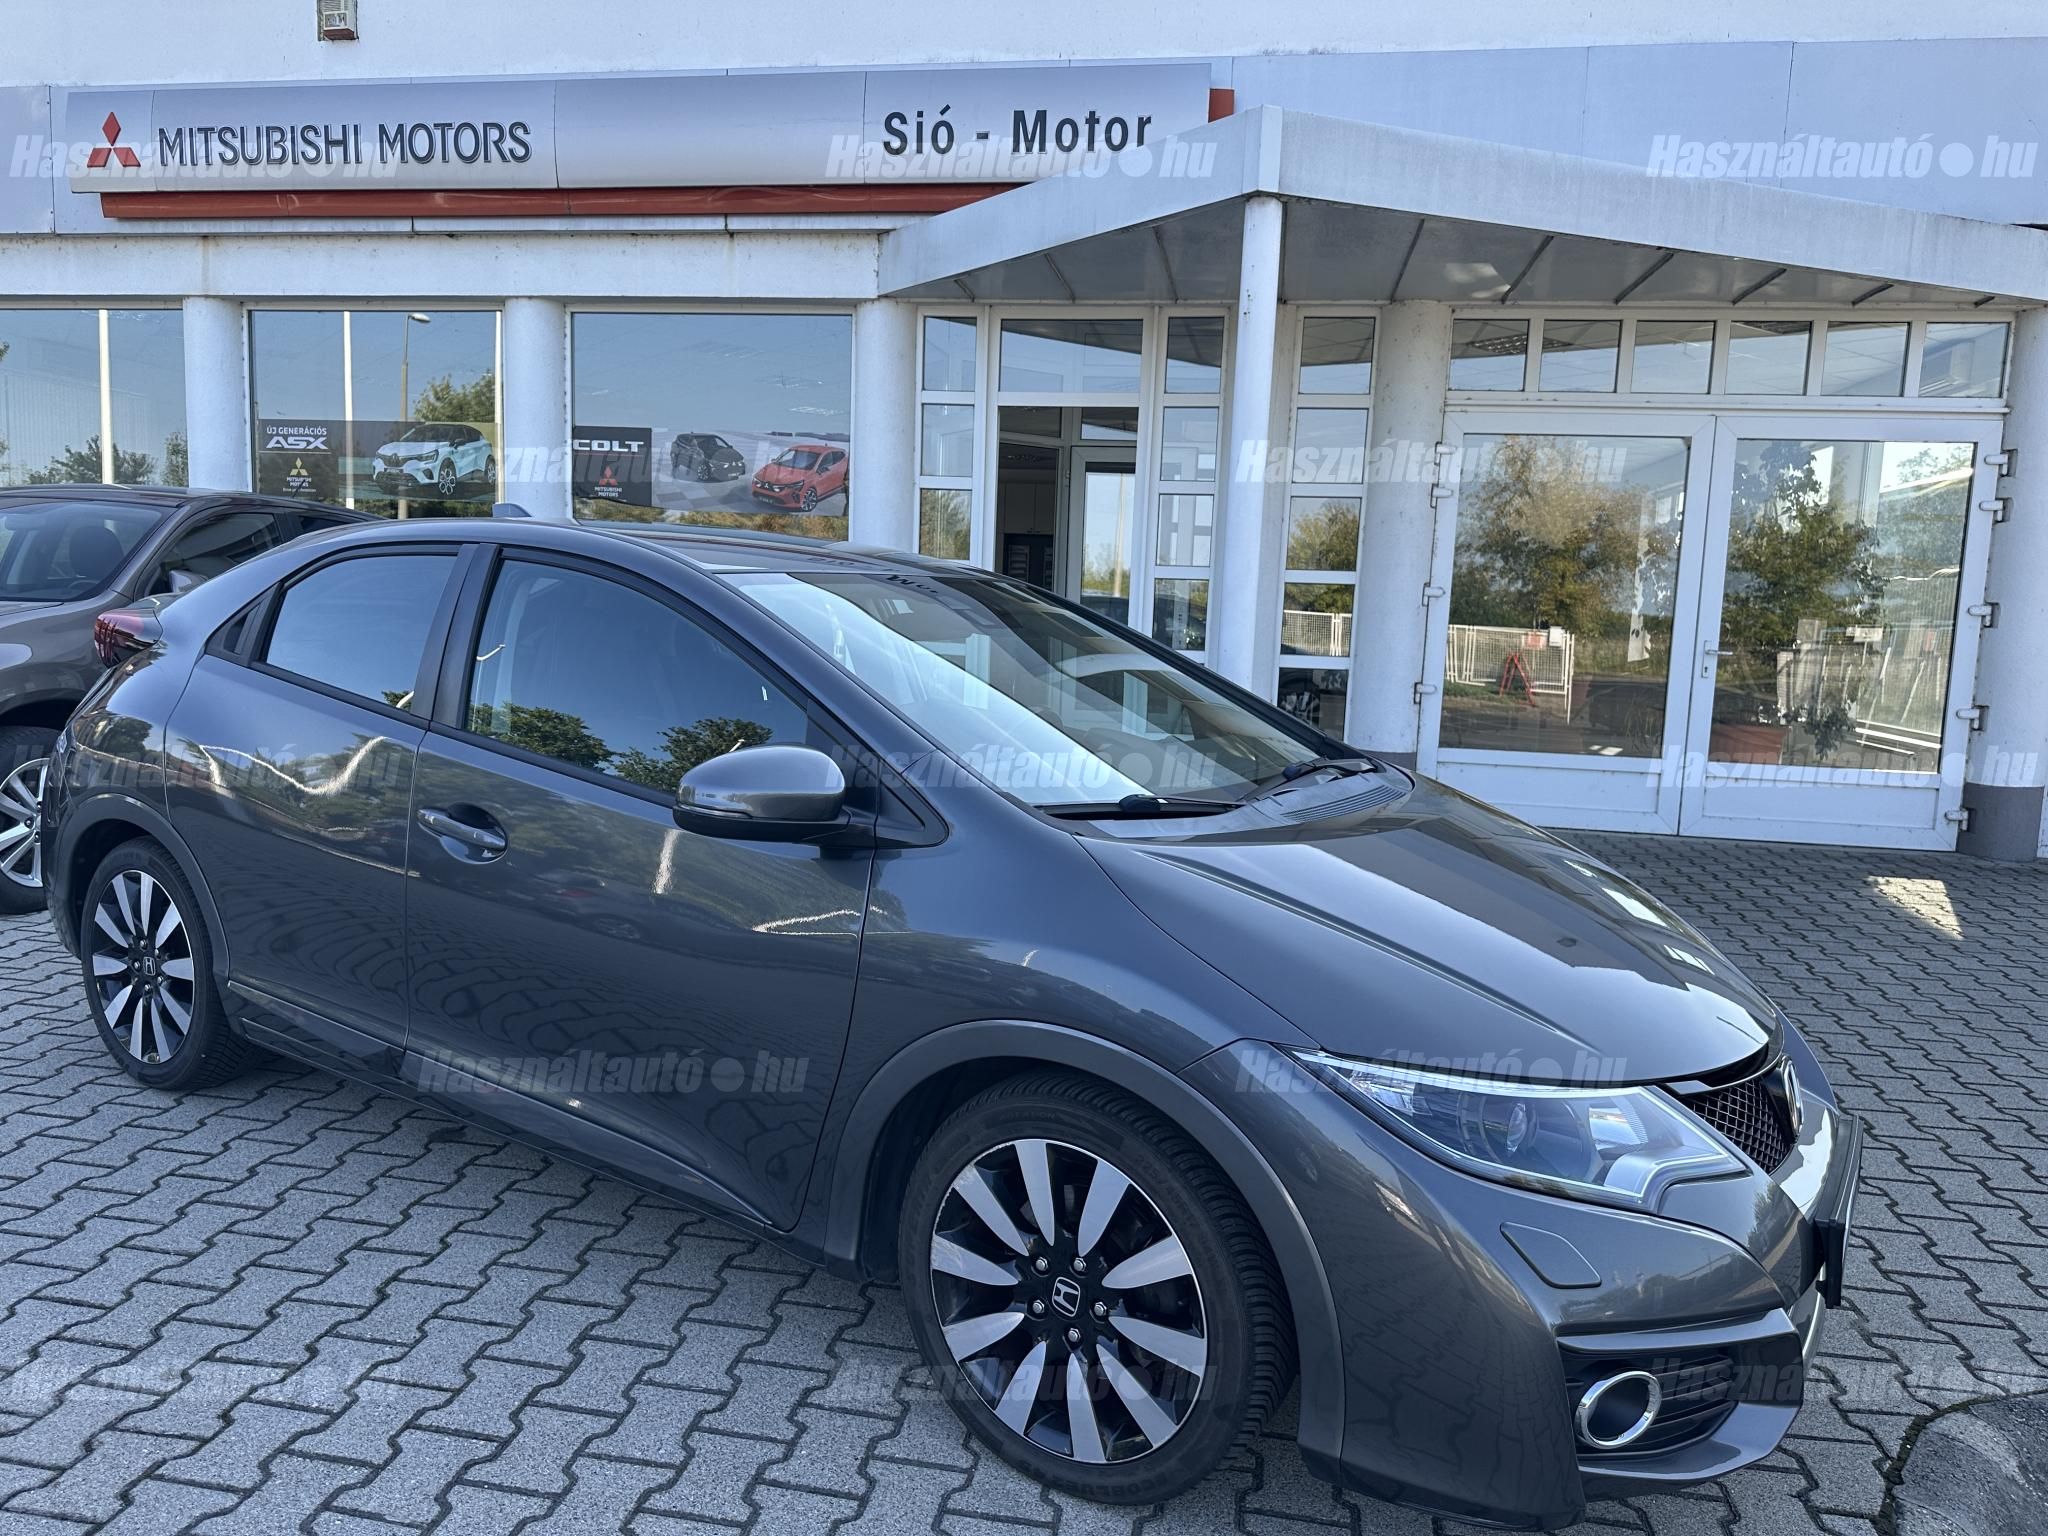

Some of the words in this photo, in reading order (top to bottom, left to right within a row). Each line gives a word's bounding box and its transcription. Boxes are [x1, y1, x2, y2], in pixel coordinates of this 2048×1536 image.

[883, 104, 955, 155] Sió
[1012, 109, 1152, 154] Motor
[158, 123, 362, 166] MITSUBISHI
[378, 121, 532, 163] MOTORS
[278, 426, 327, 435] GENERÁCIÓS
[266, 436, 329, 449] ASX
[573, 440, 644, 452] COLT
